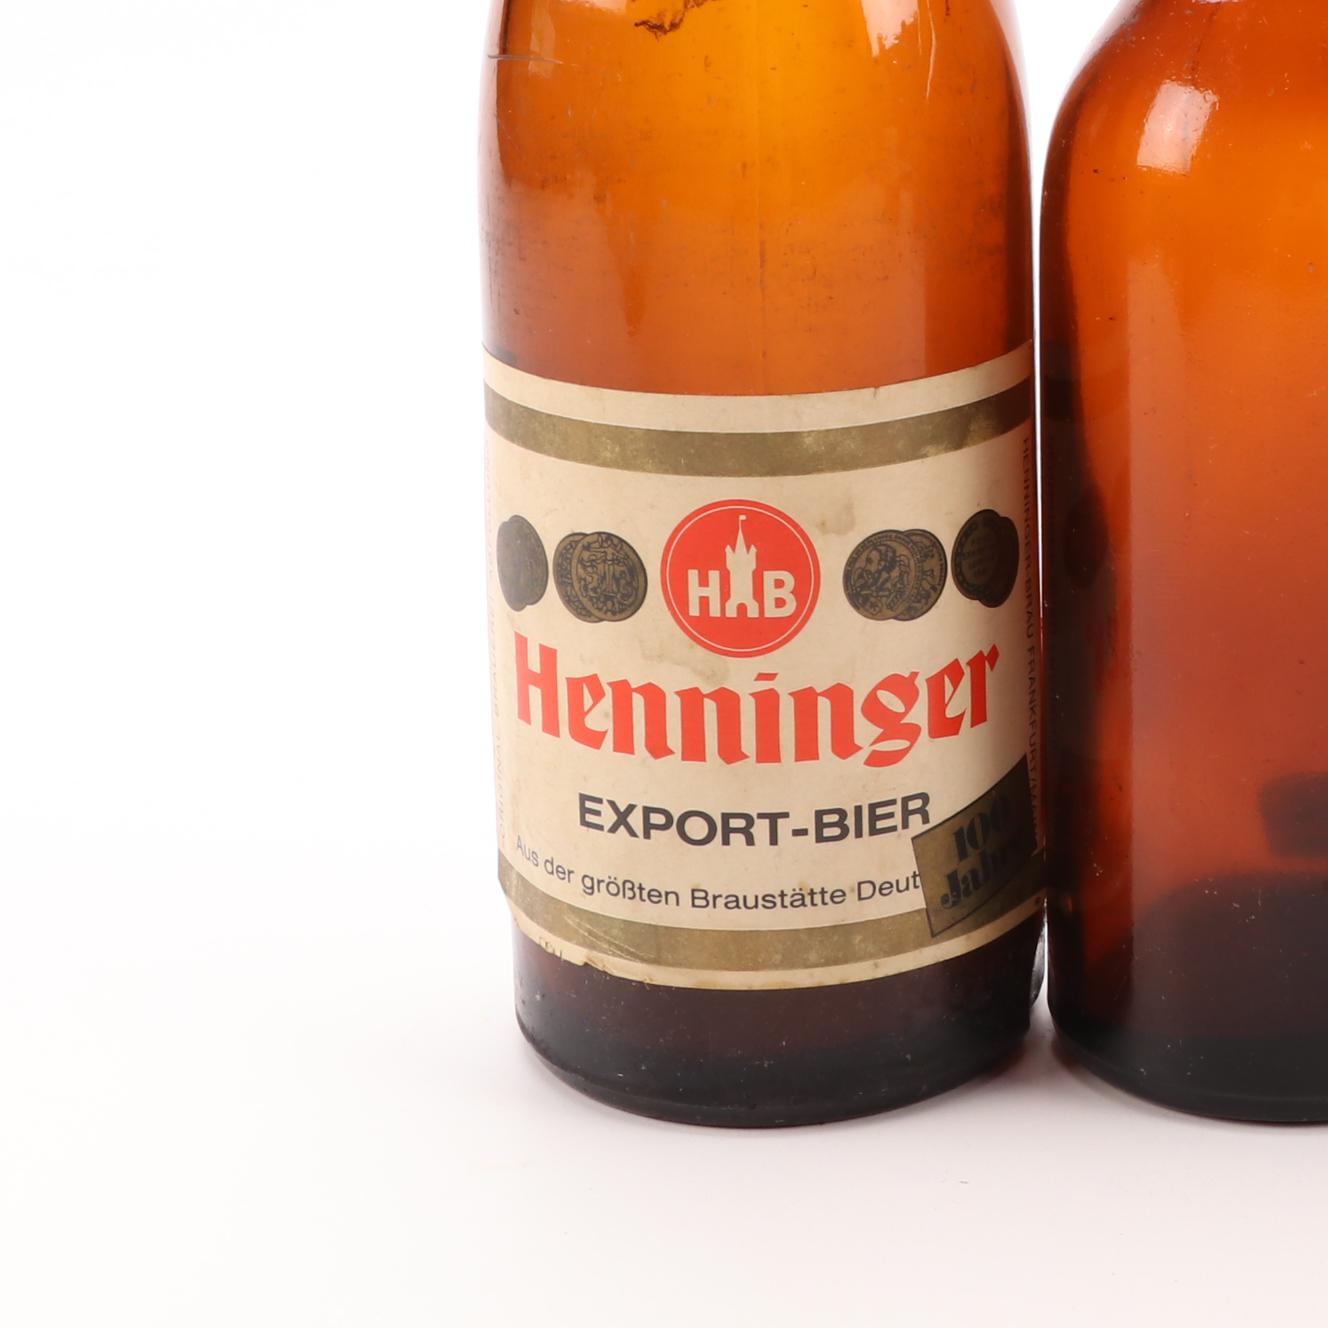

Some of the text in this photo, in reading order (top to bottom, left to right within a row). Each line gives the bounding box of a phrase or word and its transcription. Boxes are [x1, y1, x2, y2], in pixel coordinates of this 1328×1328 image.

[514, 630, 1000, 768] Henninger
[578, 791, 931, 847] EXPORT-BIER
[516, 834, 540, 868] Aus
[543, 856, 575, 884] der
[581, 873, 680, 907] größten
[690, 886, 848, 911] Braustätte
